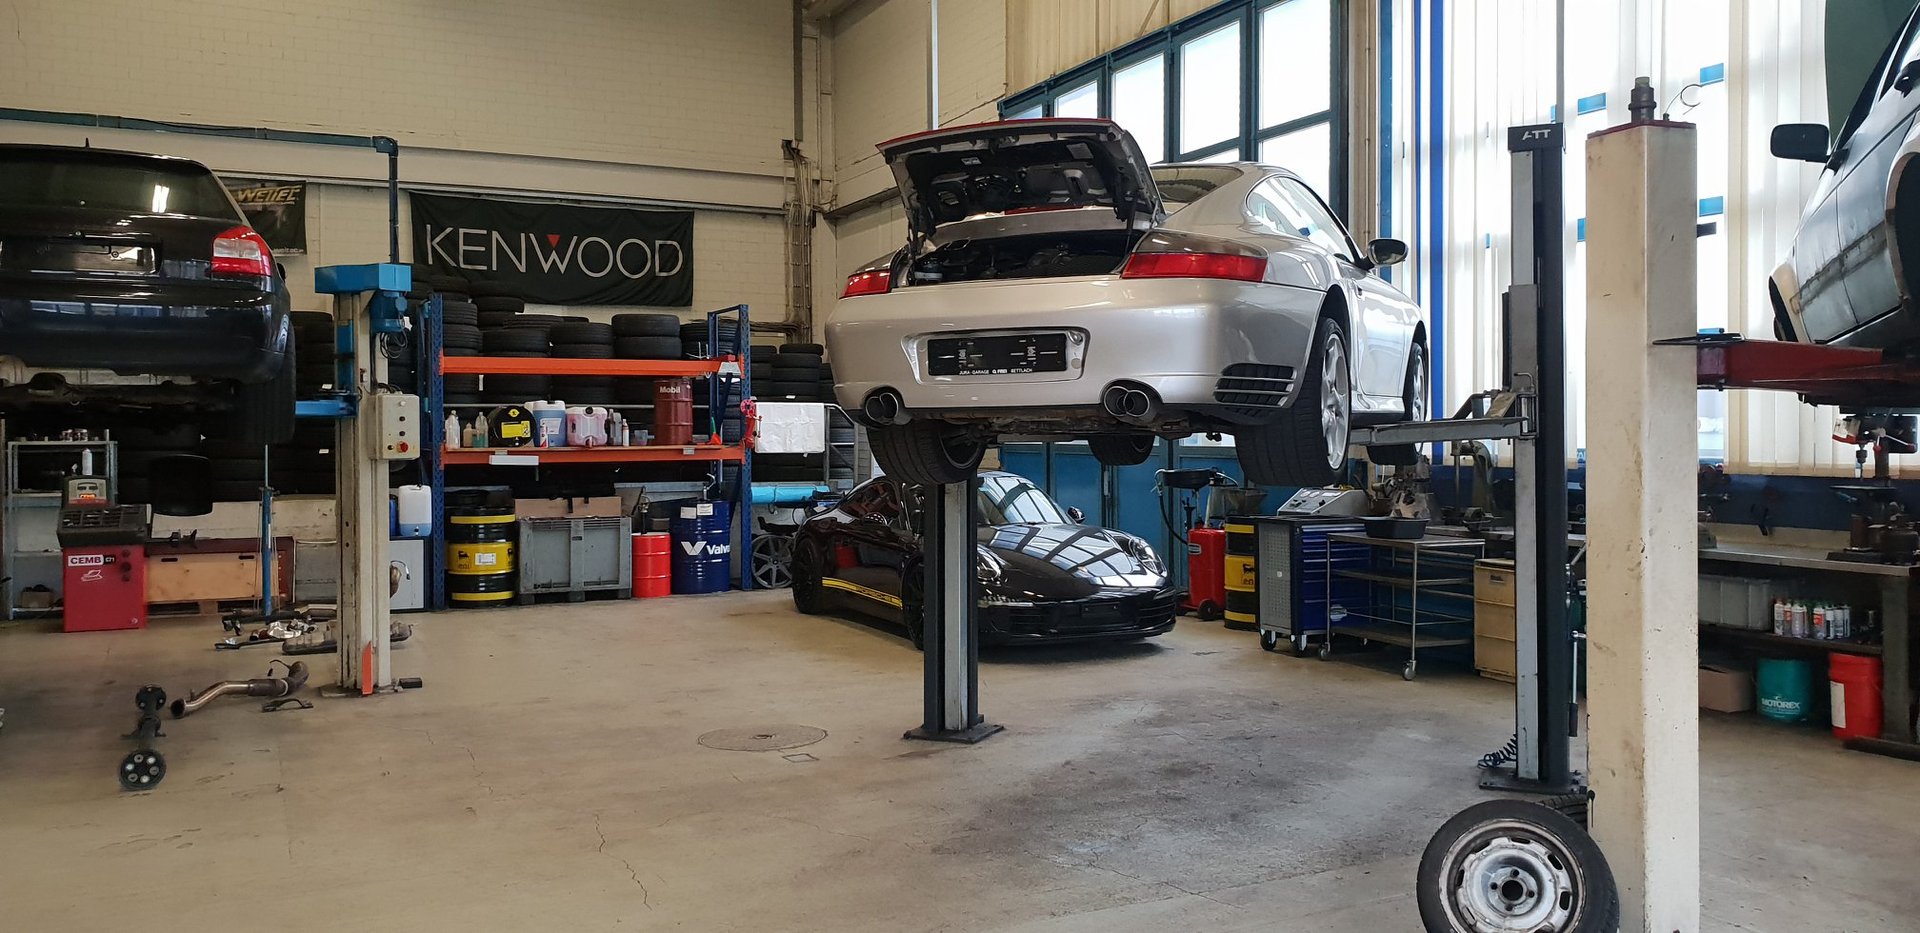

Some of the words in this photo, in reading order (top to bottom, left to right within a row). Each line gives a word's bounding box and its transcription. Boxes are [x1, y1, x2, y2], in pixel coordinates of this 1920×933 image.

[1522, 129, 1552, 140] ATT
[426, 223, 684, 279] KENWOOD
[70, 556, 101, 564] CEMB
[1761, 698, 1800, 709] MOTOREX
